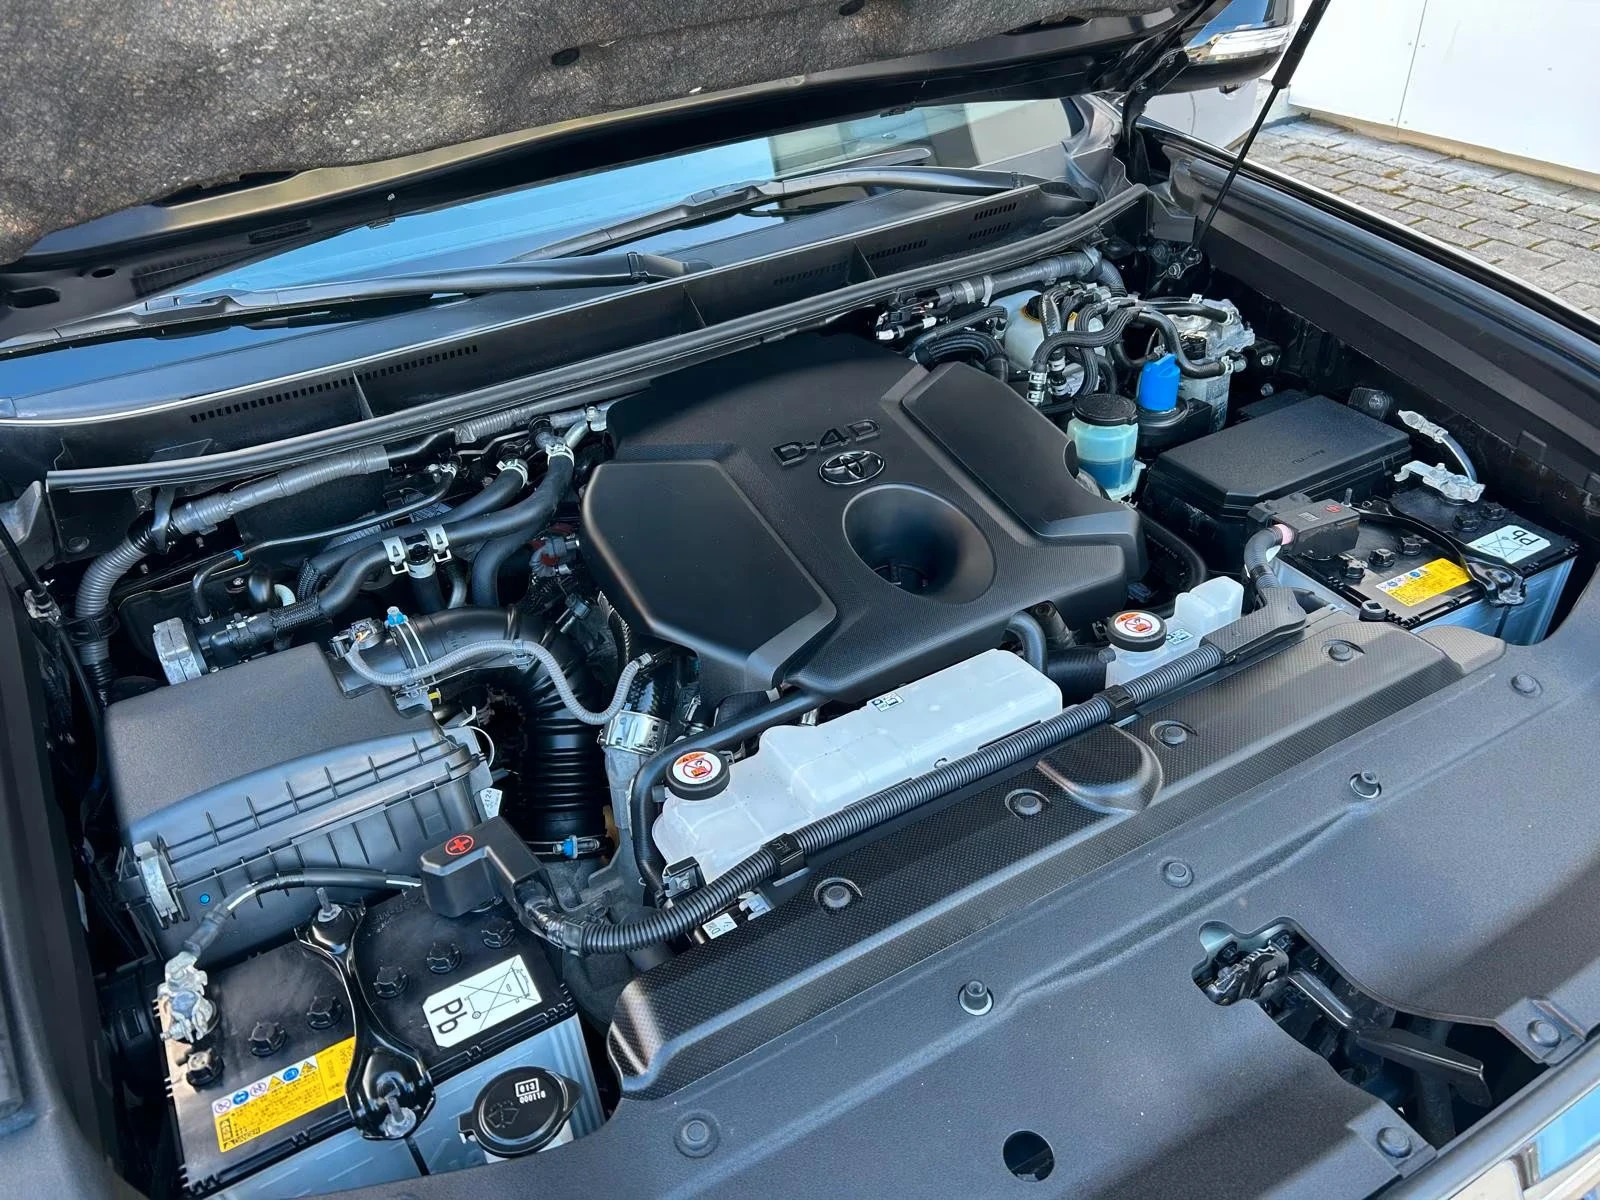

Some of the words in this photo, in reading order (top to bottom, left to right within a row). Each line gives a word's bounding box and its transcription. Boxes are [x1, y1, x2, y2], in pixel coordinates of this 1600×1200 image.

[771, 419, 880, 466] D-4D
[1512, 529, 1541, 546] Pb
[429, 997, 468, 1034] Pb
